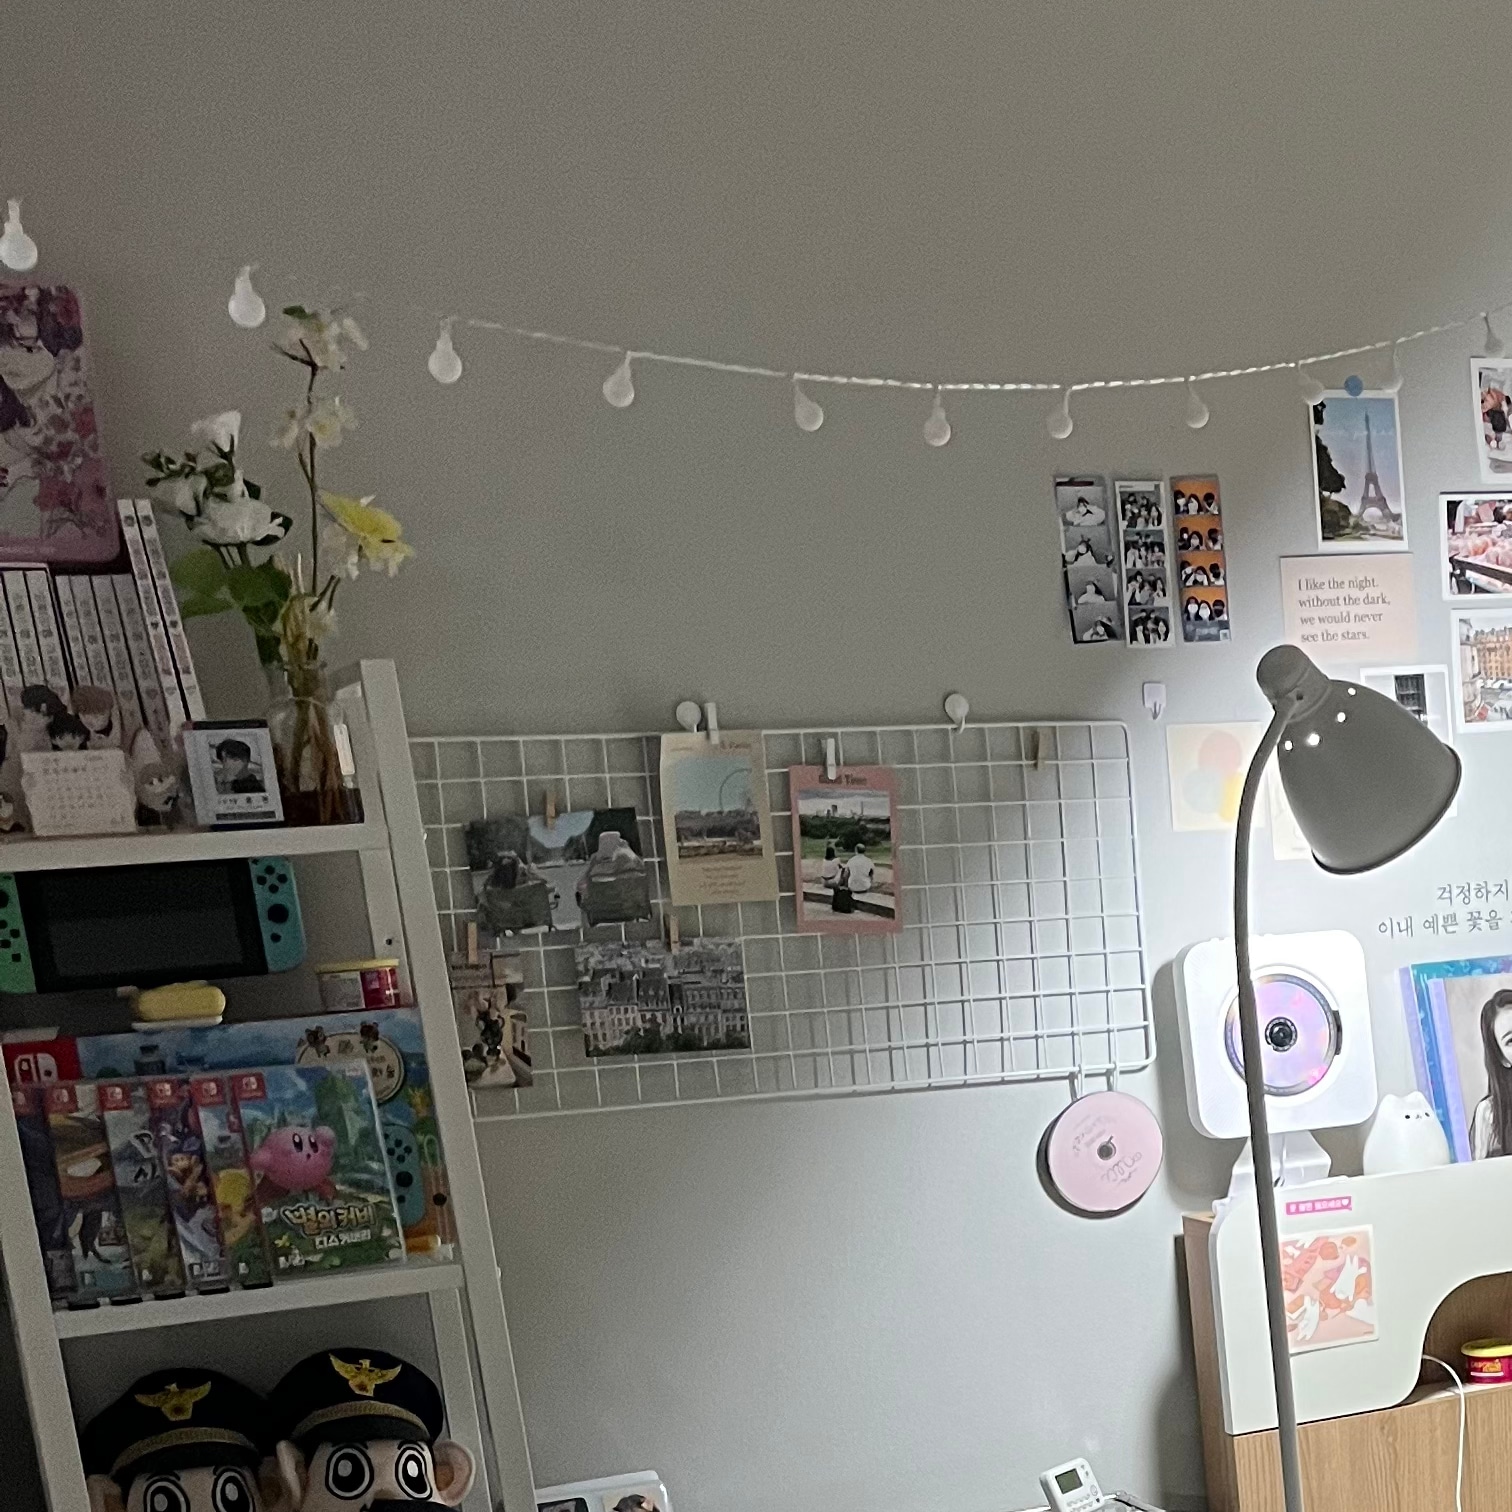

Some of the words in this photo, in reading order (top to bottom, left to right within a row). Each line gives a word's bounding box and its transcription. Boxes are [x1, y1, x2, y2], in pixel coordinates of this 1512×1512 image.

[1305, 578, 1326, 591] like
[1328, 576, 1345, 590] the
[1298, 595, 1341, 608] without
[1343, 594, 1360, 606] the
[1300, 616, 1315, 625] we
[1318, 611, 1351, 624] would
[1354, 613, 1383, 623] never
[1301, 633, 1319, 643] see
[1321, 629, 1338, 642] the
[1437, 878, 1509, 907] 걱정하지
[1378, 915, 1414, 939] 이내
[1423, 912, 1459, 936] 예쁜
[1466, 909, 1503, 933] 꽃을
